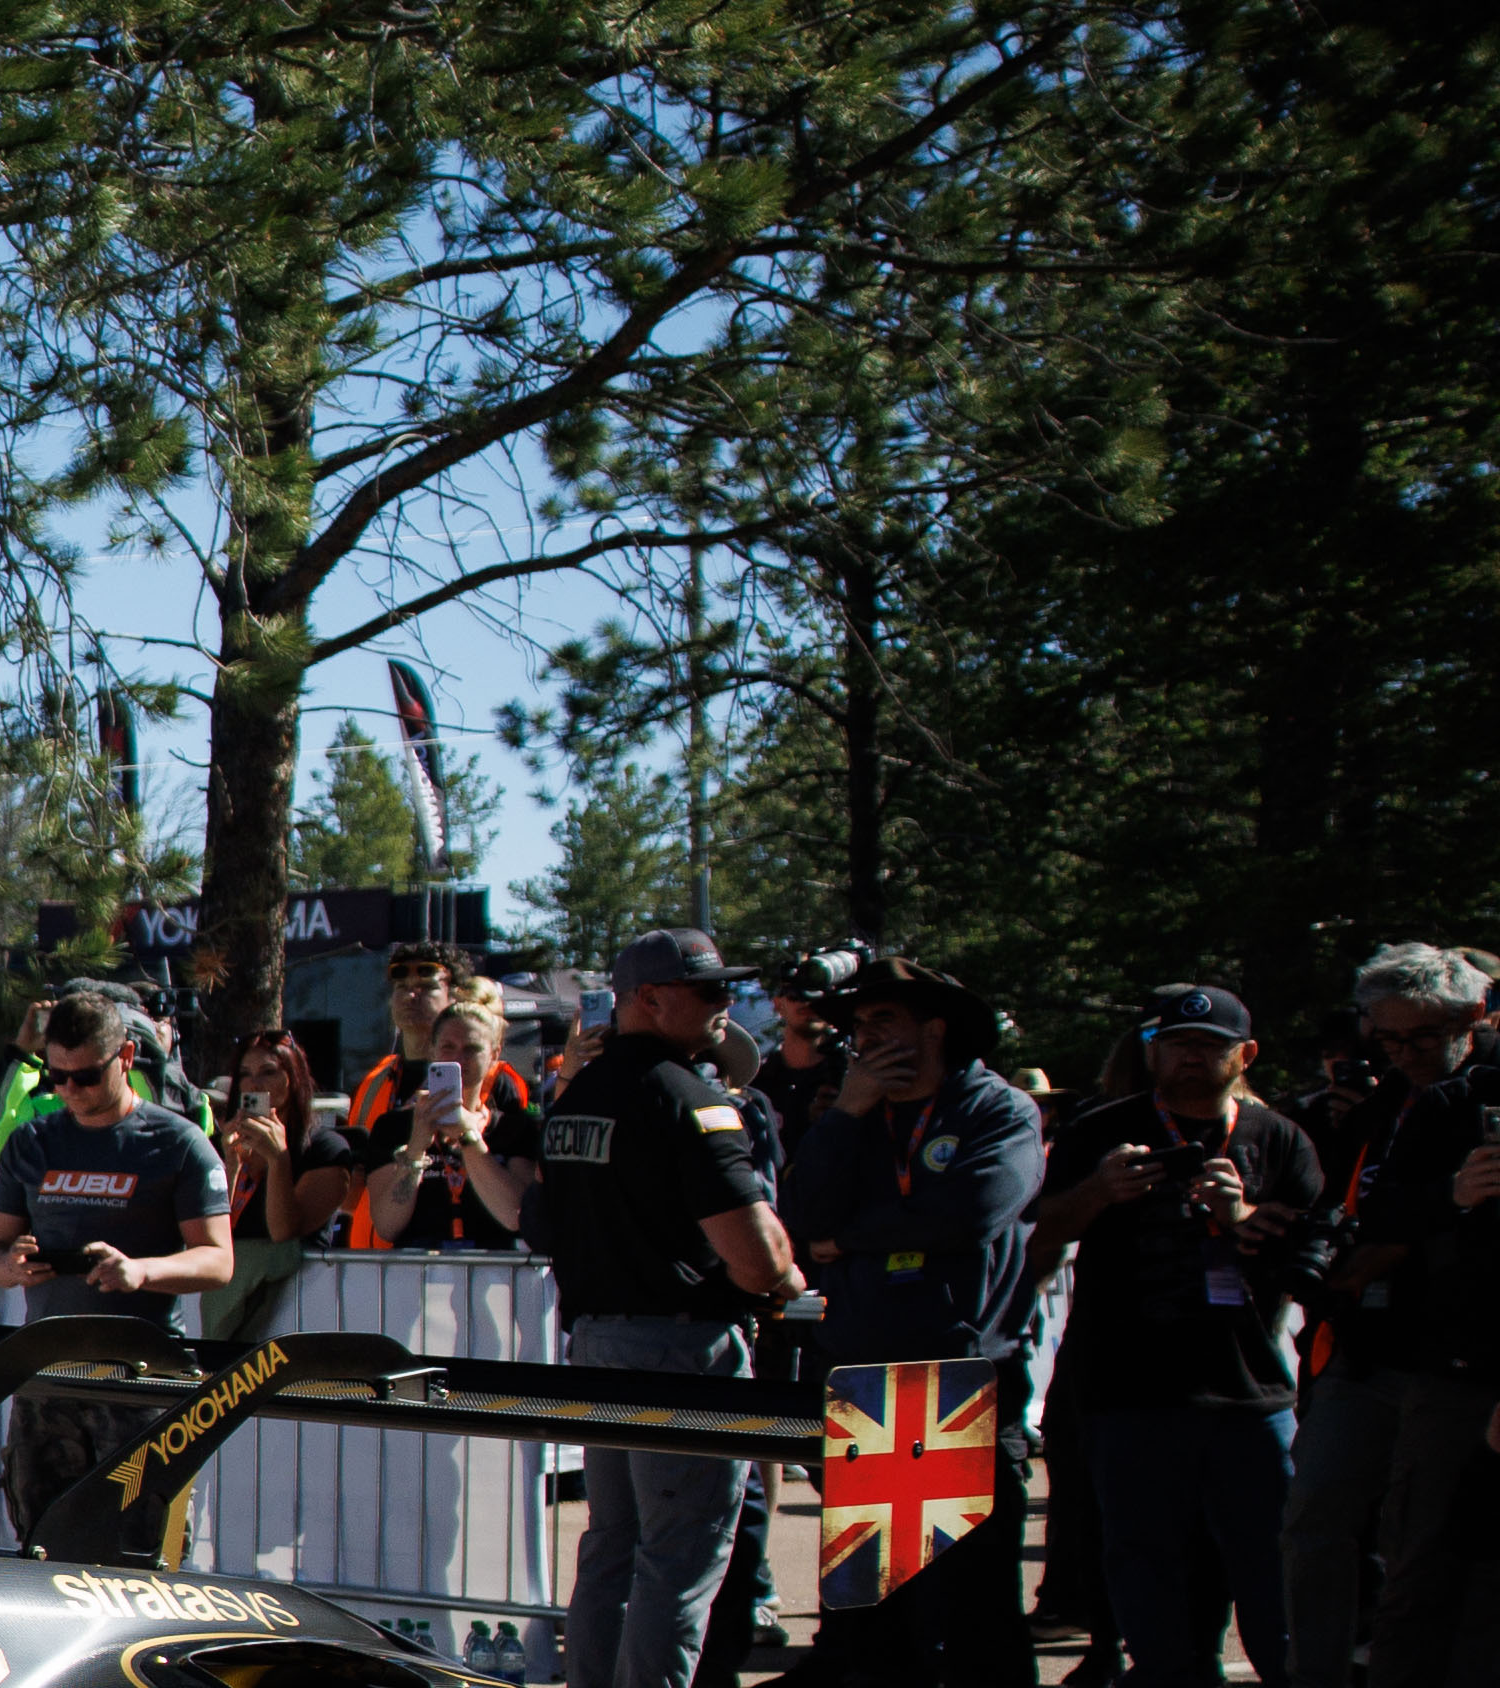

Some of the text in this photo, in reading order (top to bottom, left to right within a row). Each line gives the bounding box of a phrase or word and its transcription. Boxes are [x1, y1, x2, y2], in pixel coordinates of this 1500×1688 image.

[37, 1194, 129, 1209] PERFORMANCE
[43, 1173, 134, 1195] JUBU
[150, 1341, 290, 1465] YOKOHAMA
[52, 1569, 301, 1631] stratasys
